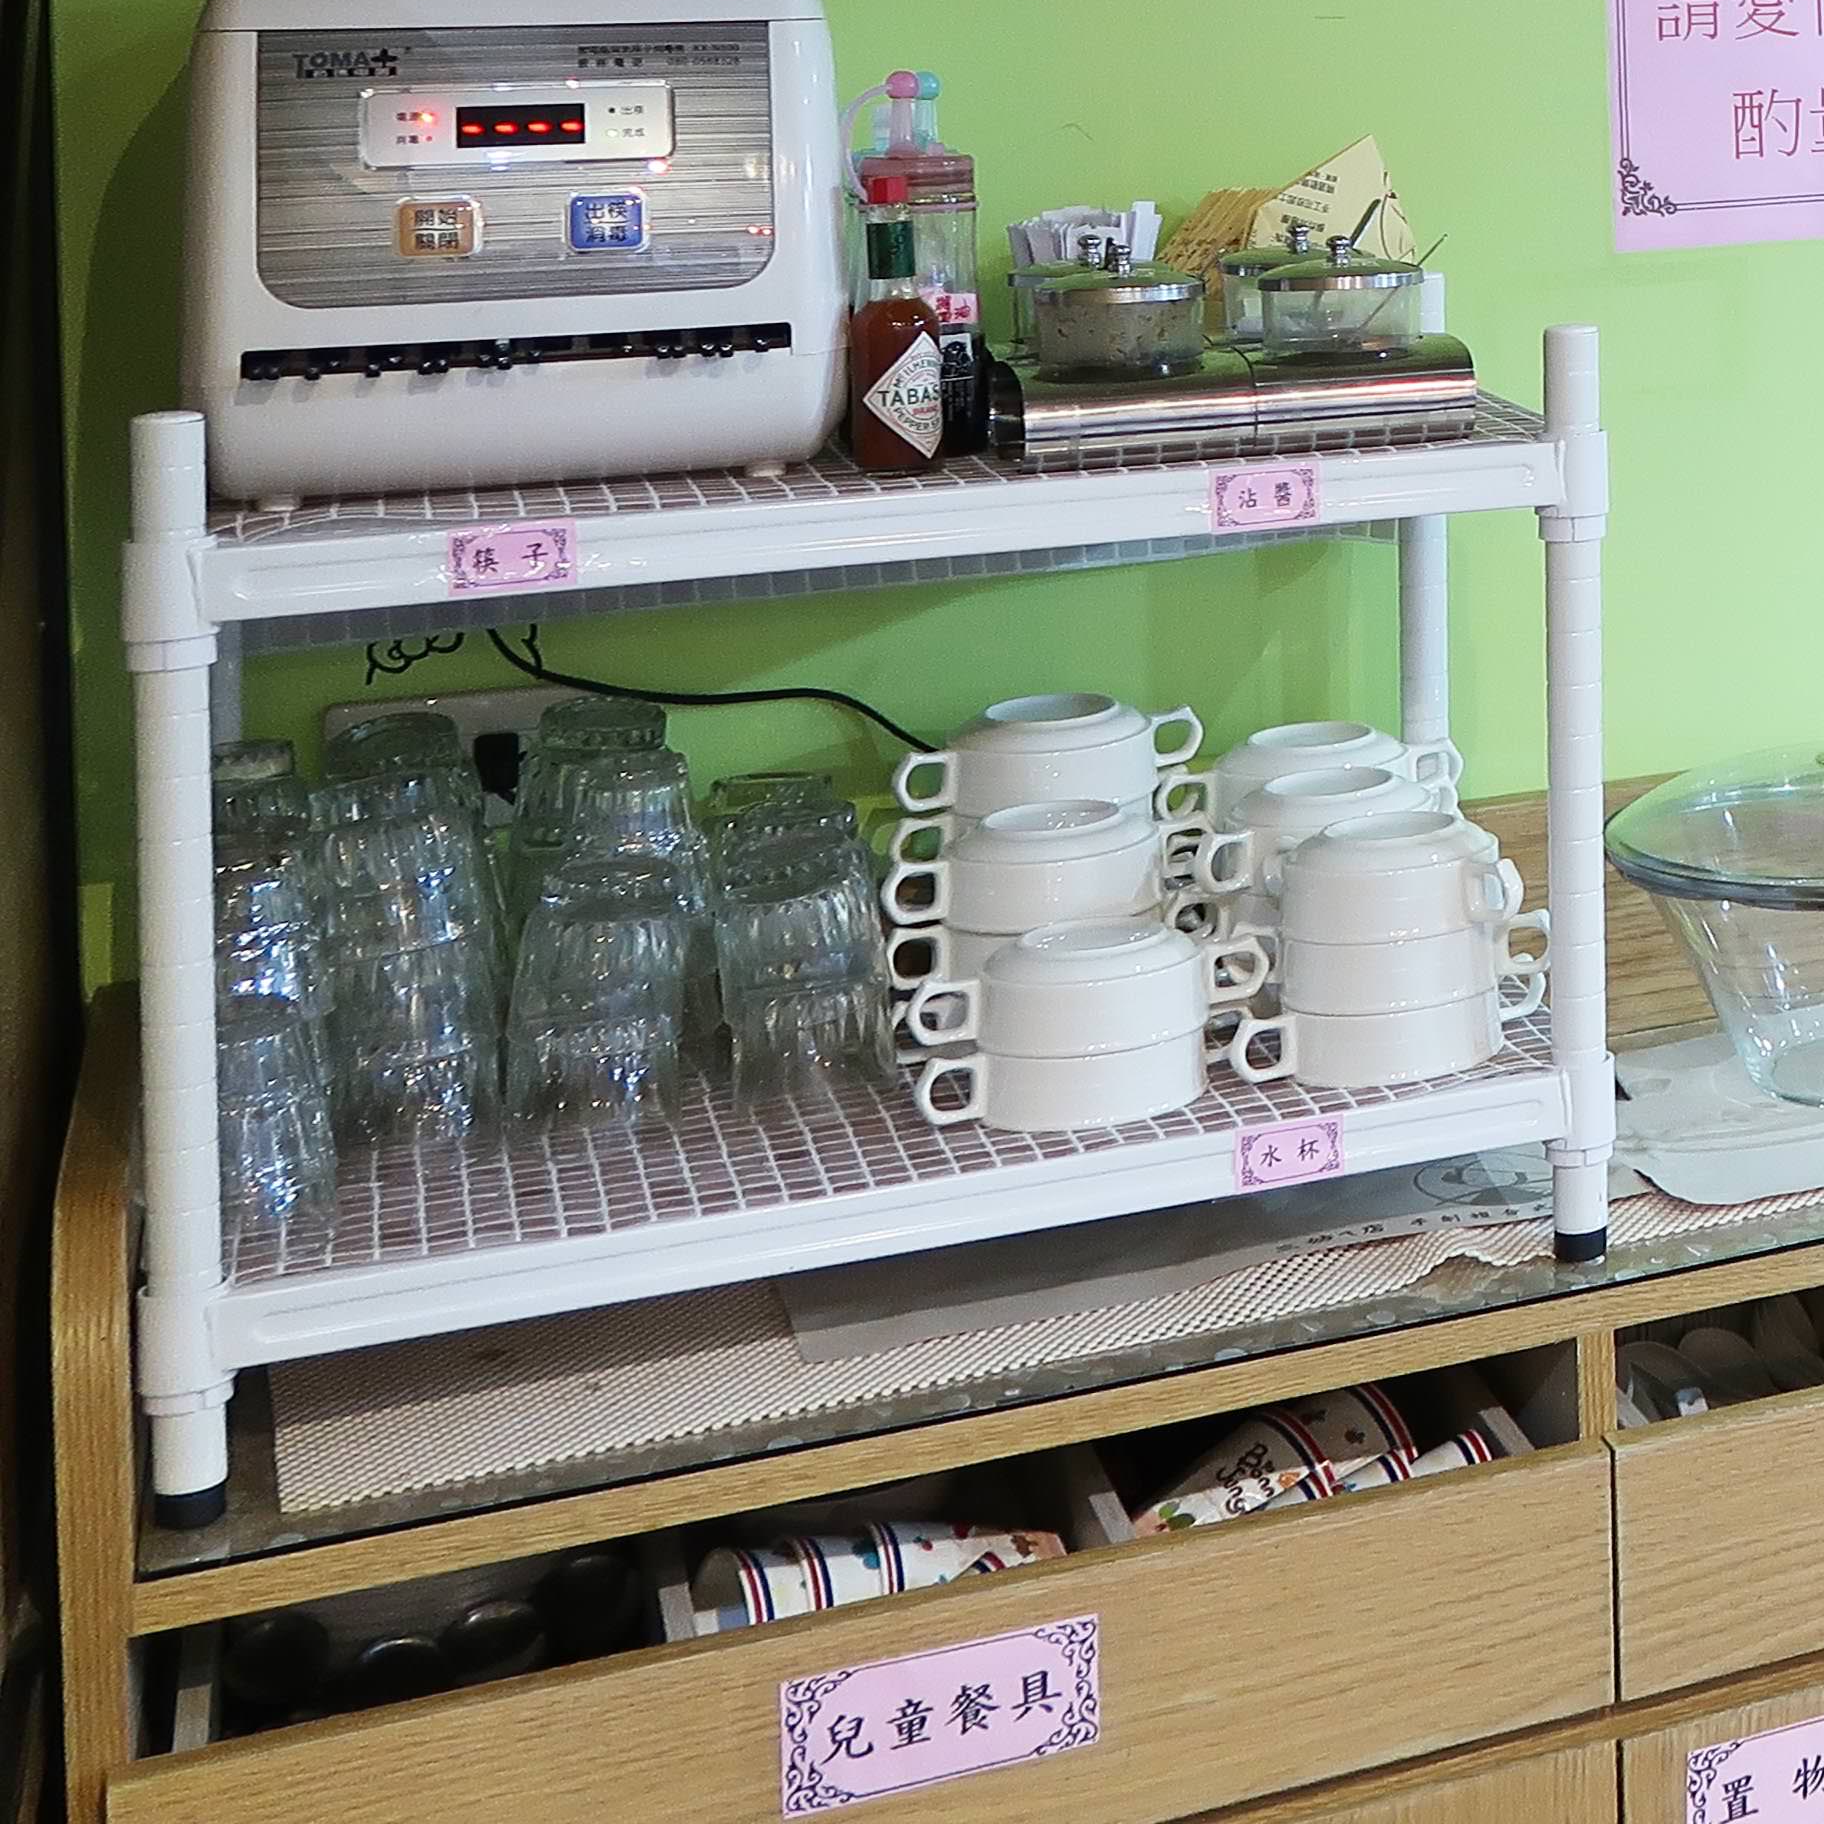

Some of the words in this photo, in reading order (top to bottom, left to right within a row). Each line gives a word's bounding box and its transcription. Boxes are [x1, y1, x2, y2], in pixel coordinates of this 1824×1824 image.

[472, 542, 549, 573] 筷子
[1260, 1137, 1320, 1168] 水杯
[819, 1669, 1063, 1766] 兒童餐具
